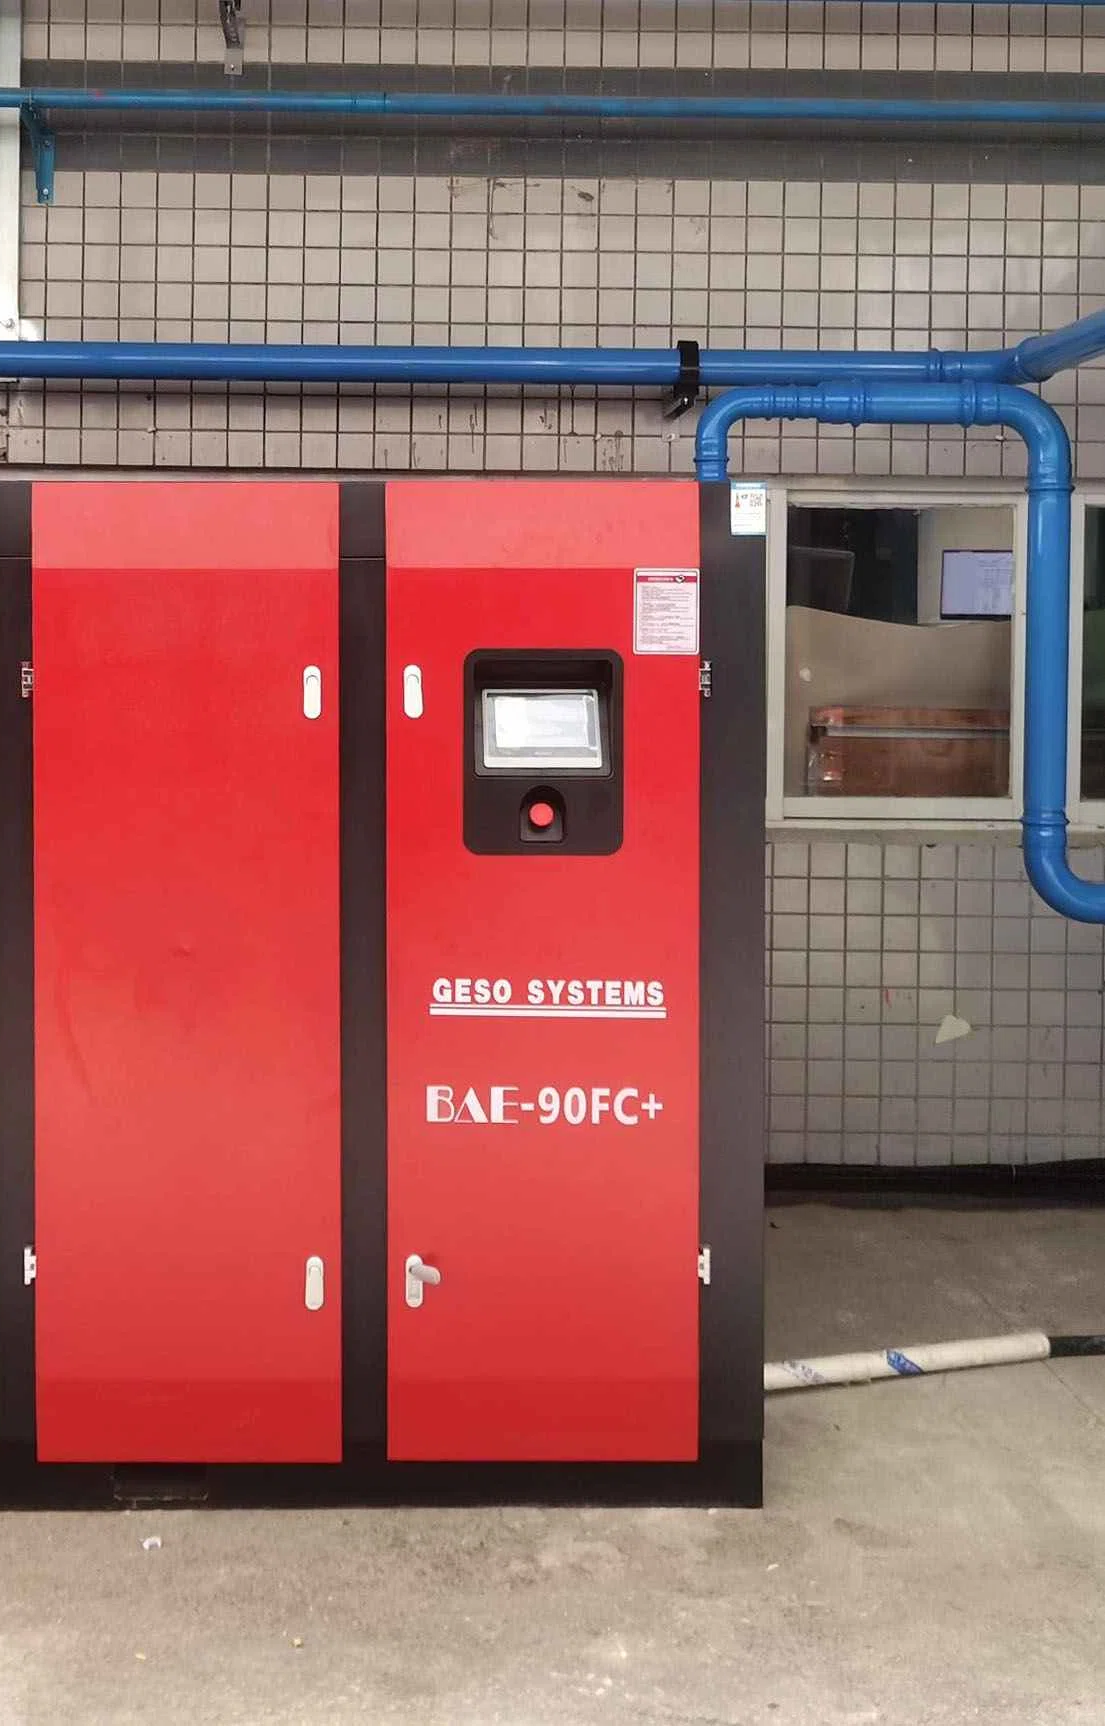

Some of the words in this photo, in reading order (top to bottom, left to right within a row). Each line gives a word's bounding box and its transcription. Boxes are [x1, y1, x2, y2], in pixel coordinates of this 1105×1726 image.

[432, 978, 512, 1003] GESO
[527, 979, 664, 1006] SYSTEMS
[426, 1085, 664, 1125] BAE-90FC+
